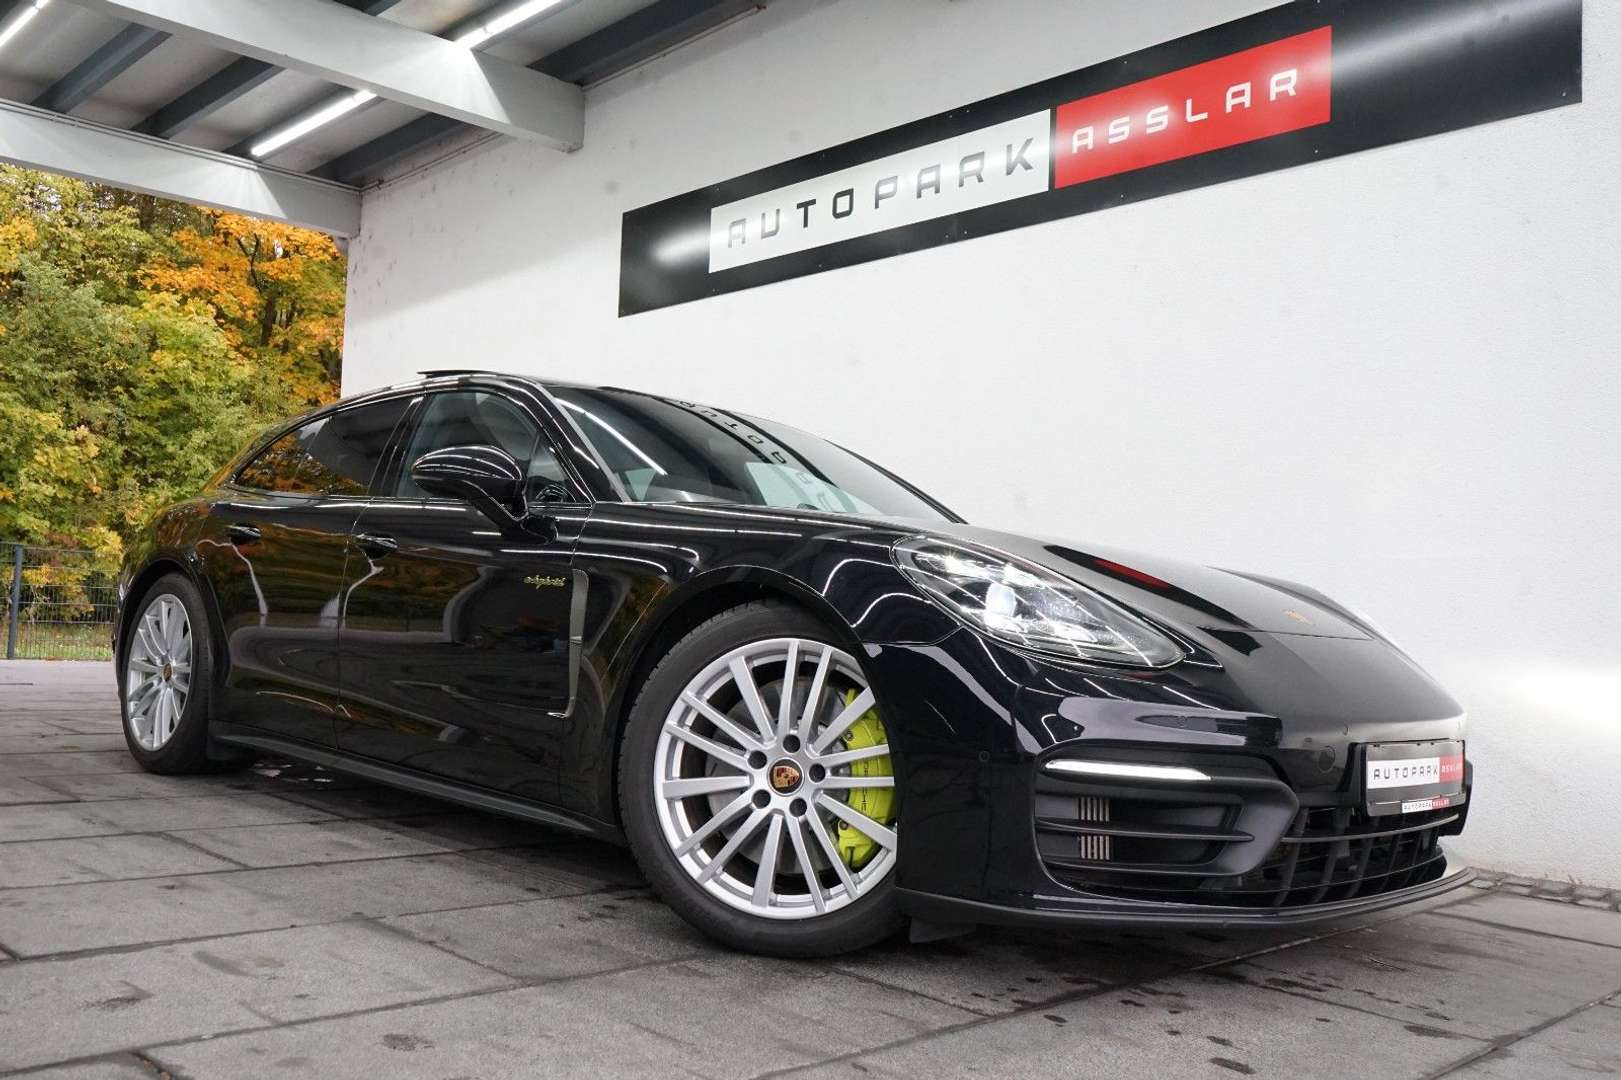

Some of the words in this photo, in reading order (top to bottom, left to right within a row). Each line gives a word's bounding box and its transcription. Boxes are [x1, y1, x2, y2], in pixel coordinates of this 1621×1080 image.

[728, 137, 1034, 248] AUTOPARK
[1071, 68, 1297, 154] ASSLAR
[1373, 764, 1438, 780] AUTOPARK
